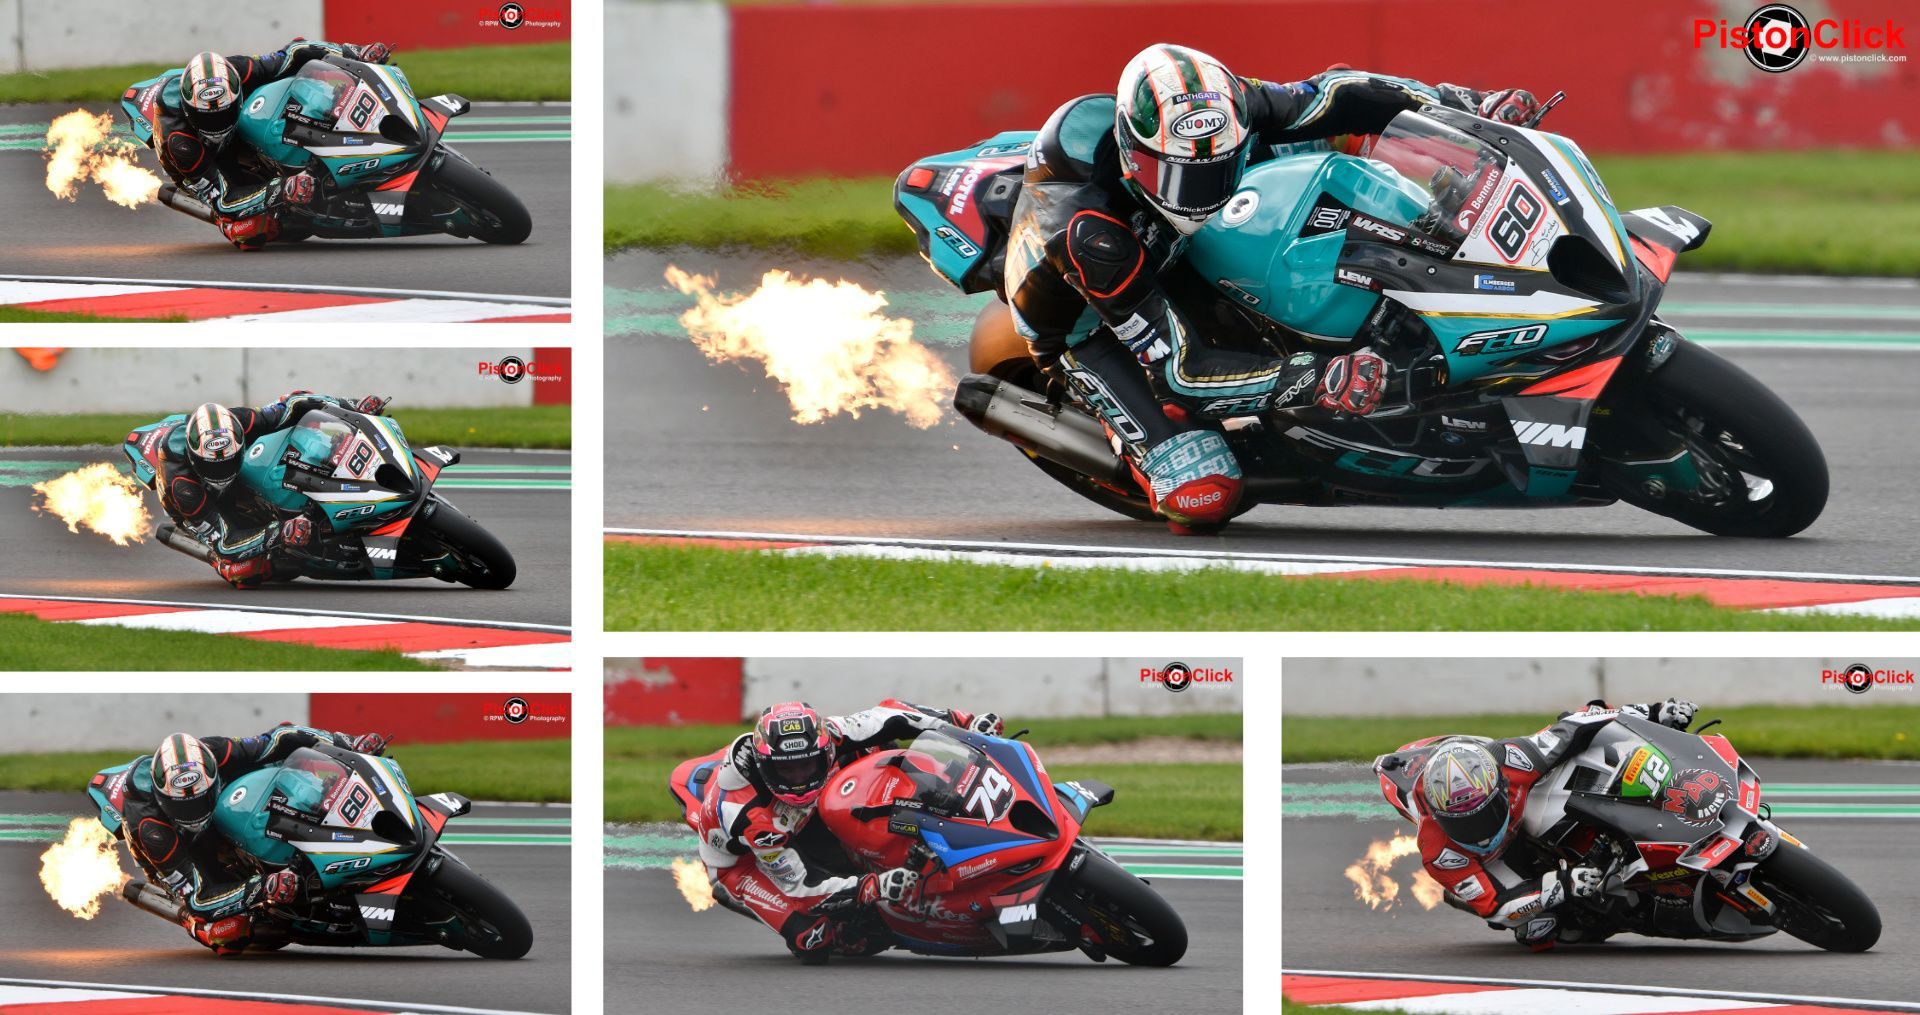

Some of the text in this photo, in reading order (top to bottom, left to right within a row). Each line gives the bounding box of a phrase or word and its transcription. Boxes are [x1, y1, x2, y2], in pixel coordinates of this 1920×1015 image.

[1175, 91, 1219, 102] BATHGATE
[349, 93, 377, 130] 60
[1178, 115, 1225, 131] SUOMY
[1470, 168, 1500, 210] Bennetts
[1352, 216, 1405, 241] WRS
[1490, 183, 1542, 259] 60
[1338, 268, 1372, 285] LEW
[1441, 415, 1487, 430] LEW
[347, 441, 375, 478] 60
[1175, 491, 1222, 509] Weise
[783, 740, 805, 750] SHOEI
[339, 783, 371, 825] 60
[964, 767, 1013, 825] 74
[1663, 771, 1721, 815] MAD
[1697, 792, 1726, 819] RACING
[957, 858, 998, 878] Milwaukee
[1646, 867, 1691, 881] Vesrah
[735, 875, 789, 910] Milwaukee
